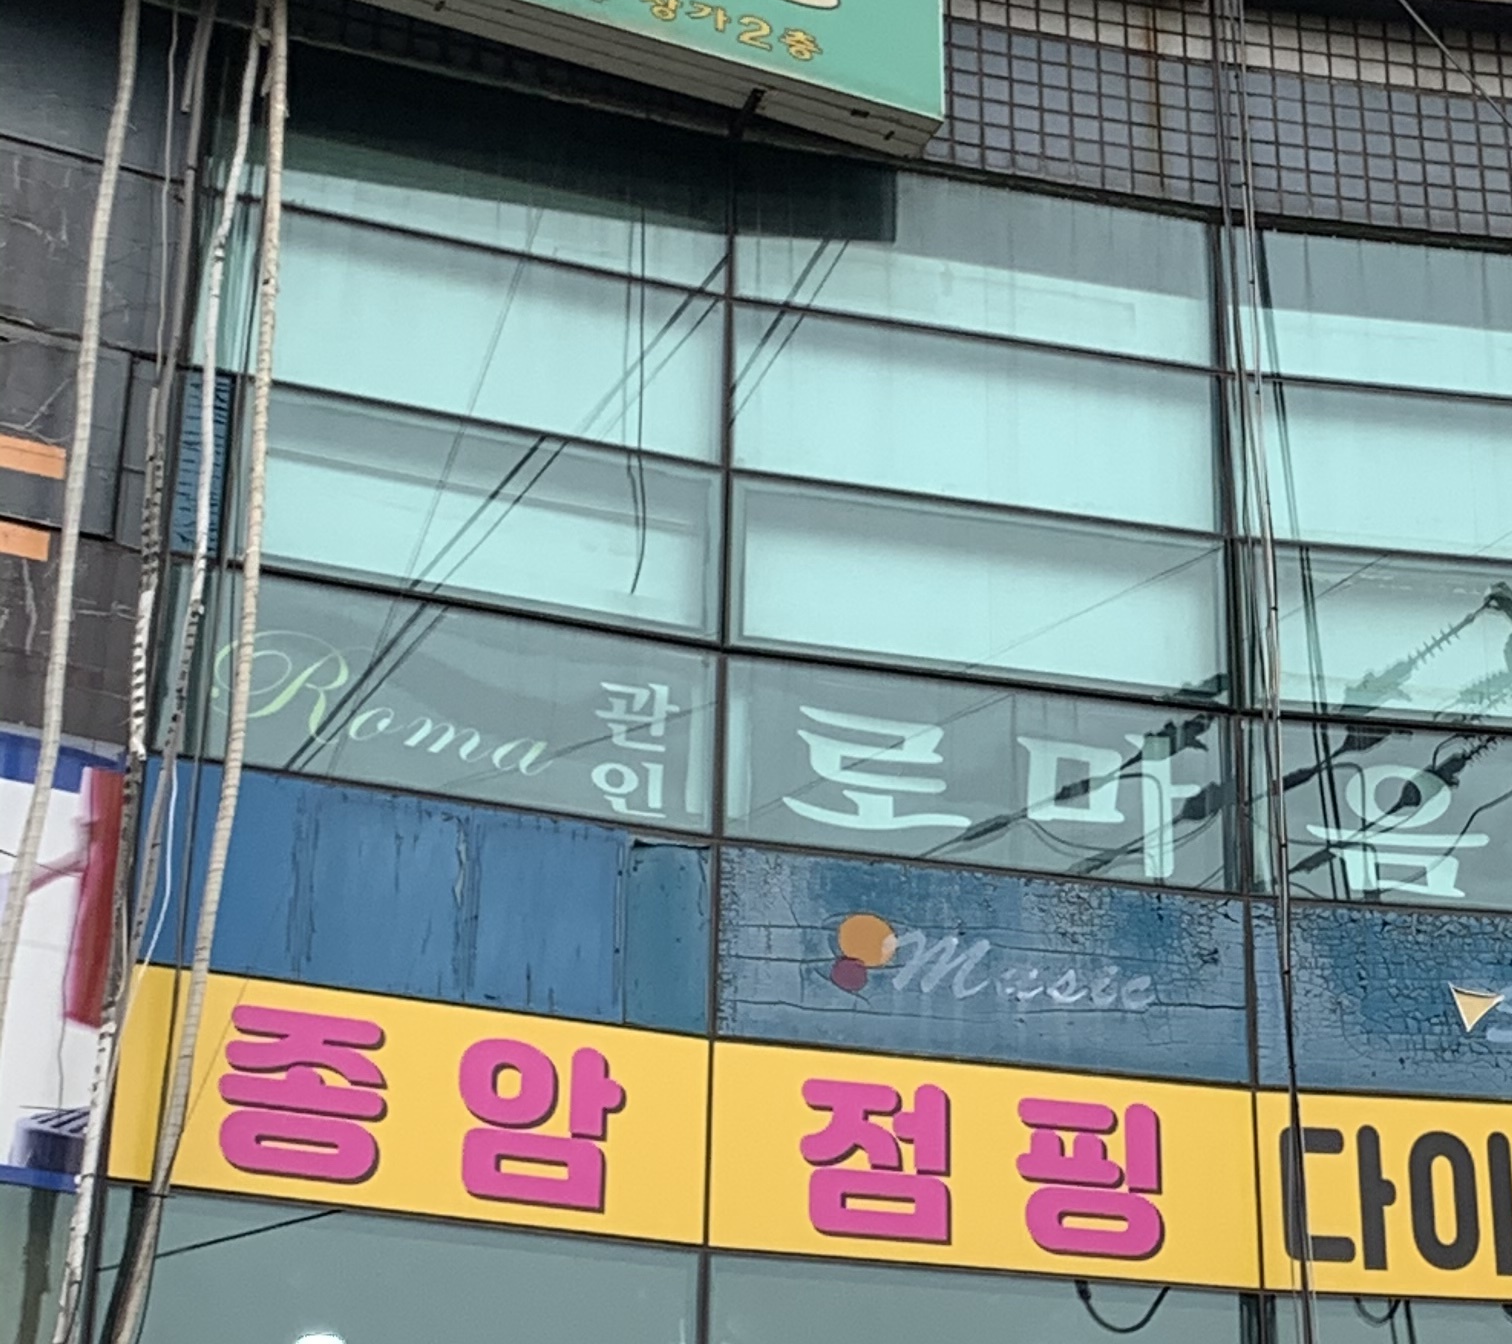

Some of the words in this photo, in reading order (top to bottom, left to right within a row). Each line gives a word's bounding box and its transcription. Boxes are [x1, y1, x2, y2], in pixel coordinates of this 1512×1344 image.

[211, 629, 555, 778] Roma
[216, 1002, 626, 1214] 종암
[798, 1076, 1166, 1259] 점핑
